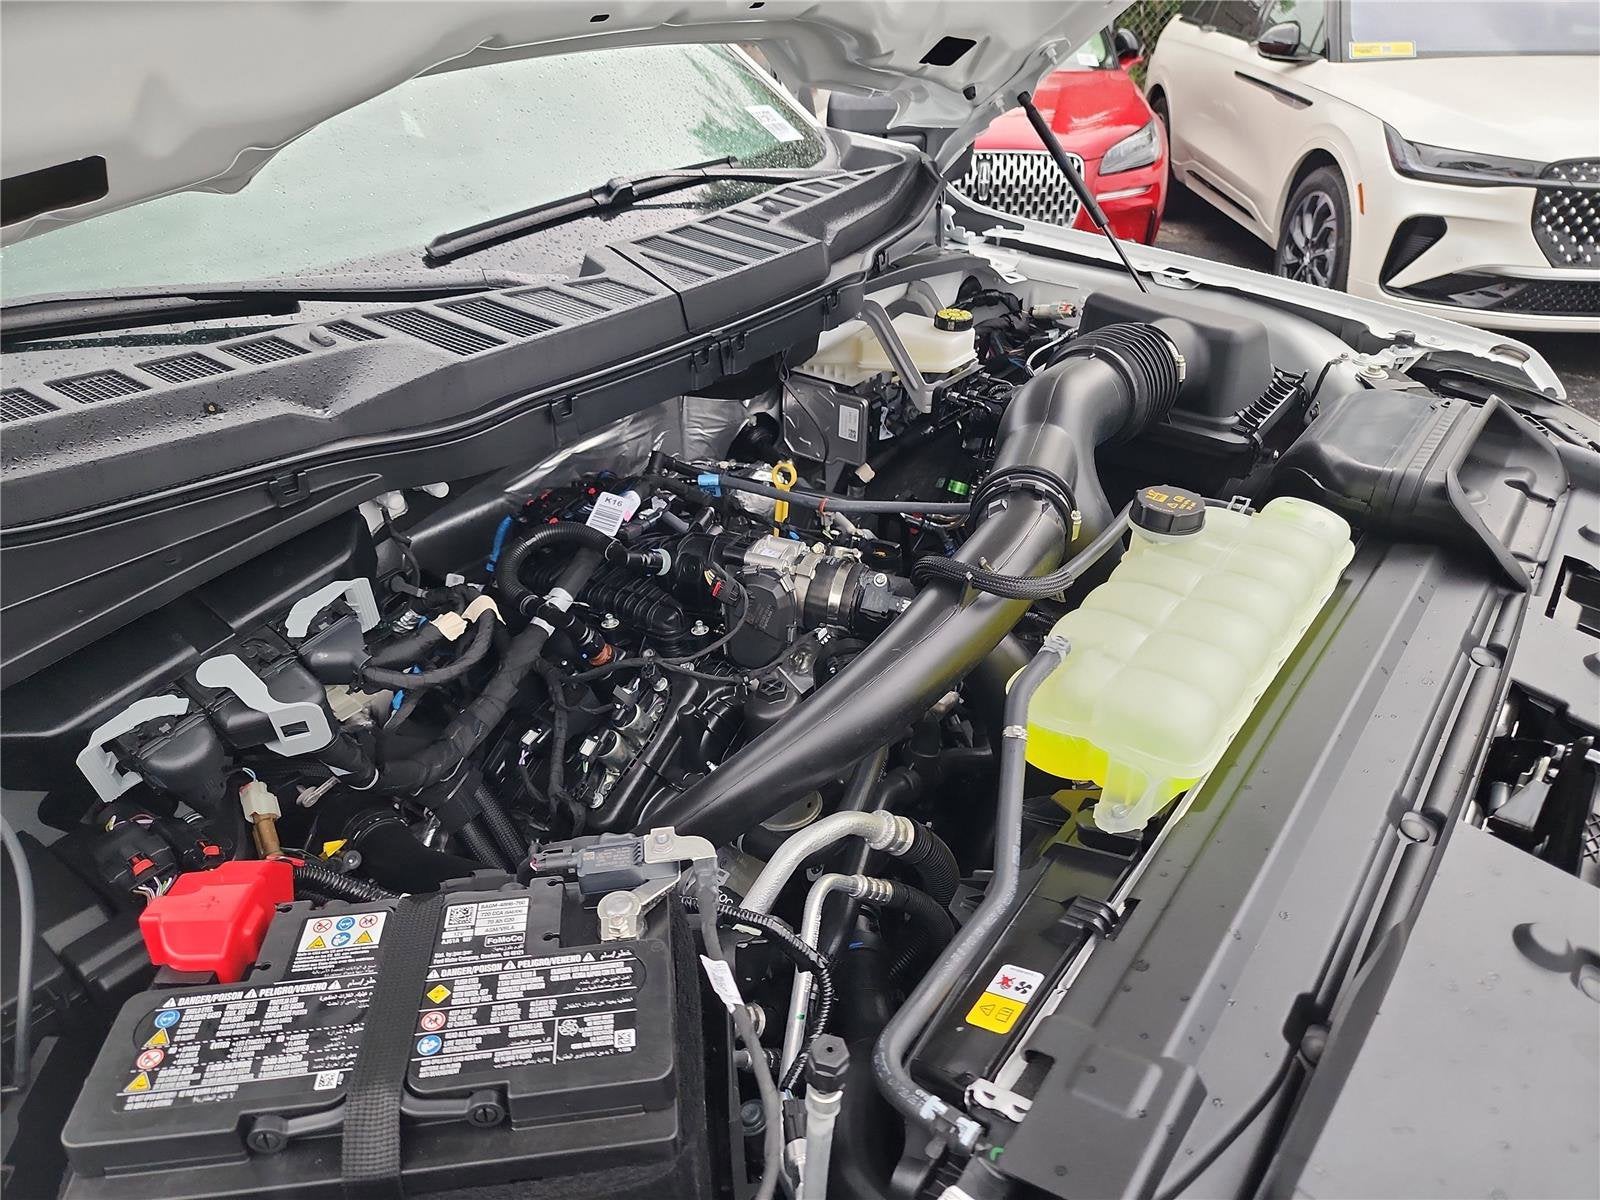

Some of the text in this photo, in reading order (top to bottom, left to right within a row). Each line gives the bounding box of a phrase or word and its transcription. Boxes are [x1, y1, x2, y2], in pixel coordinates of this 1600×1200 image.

[604, 496, 623, 507] K16
[486, 935, 523, 944] FoMoCo
[440, 954, 582, 978] DANGER/POISON PELIGRO/VENENO
[177, 982, 327, 1007] DANGER/POISON PELIGRO/VENENO
